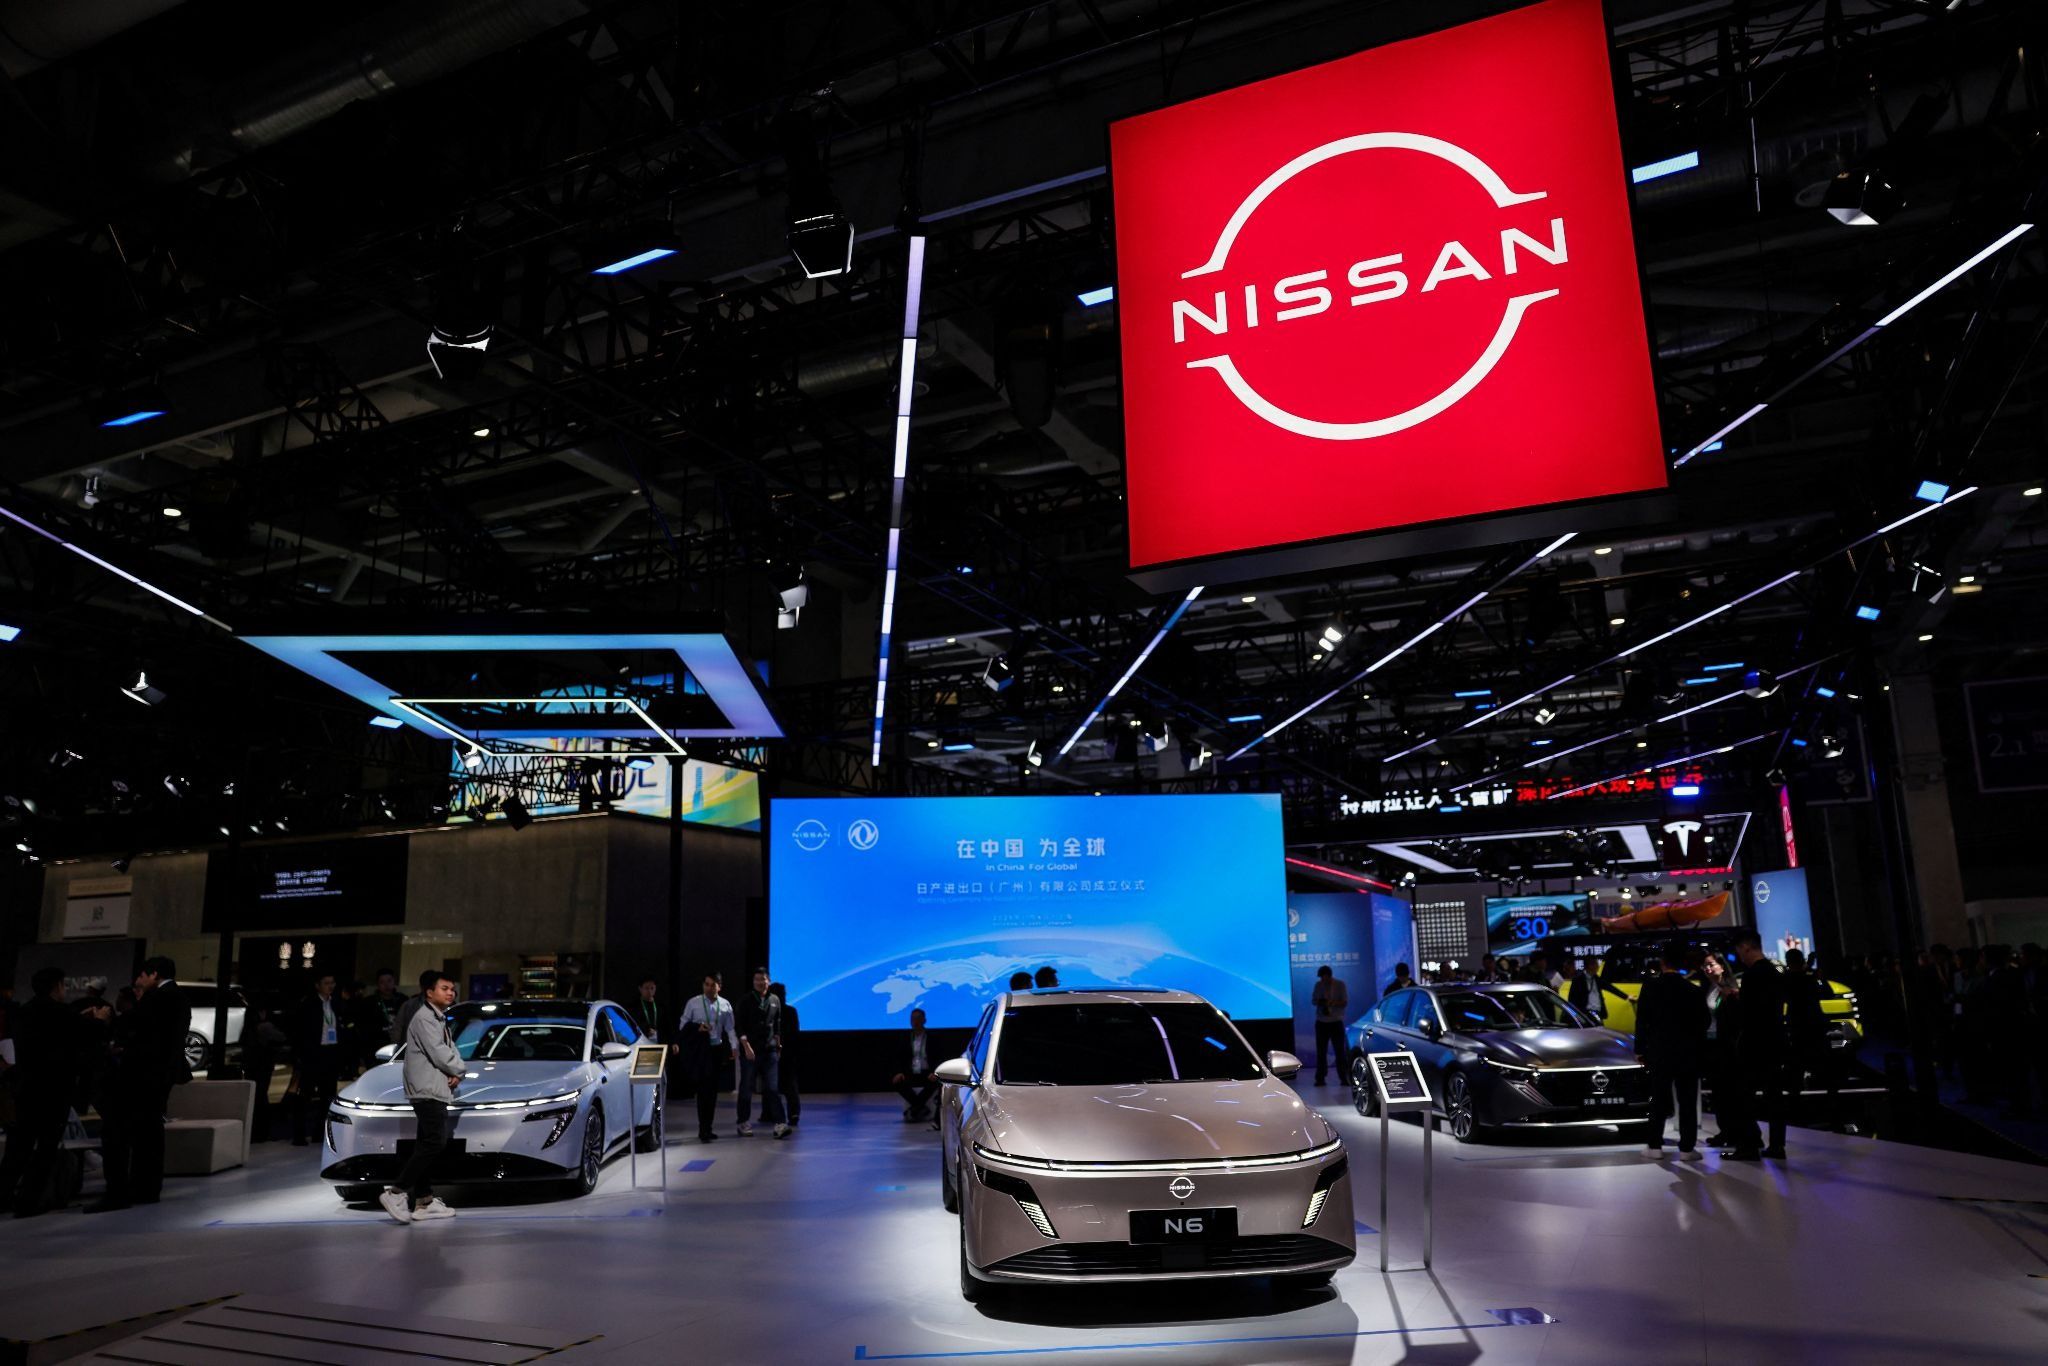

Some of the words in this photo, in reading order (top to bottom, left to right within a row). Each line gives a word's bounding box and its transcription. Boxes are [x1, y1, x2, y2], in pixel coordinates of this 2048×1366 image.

[1172, 217, 1570, 345] NISSAN
[956, 838, 1024, 859] 在中国
[1039, 837, 1106, 857] 为全球
[998, 863, 1024, 871] China
[1029, 863, 1044, 871] For
[1047, 863, 1078, 871] Global
[1515, 917, 1549, 939] 30
[1164, 1217, 1204, 1234] N6
